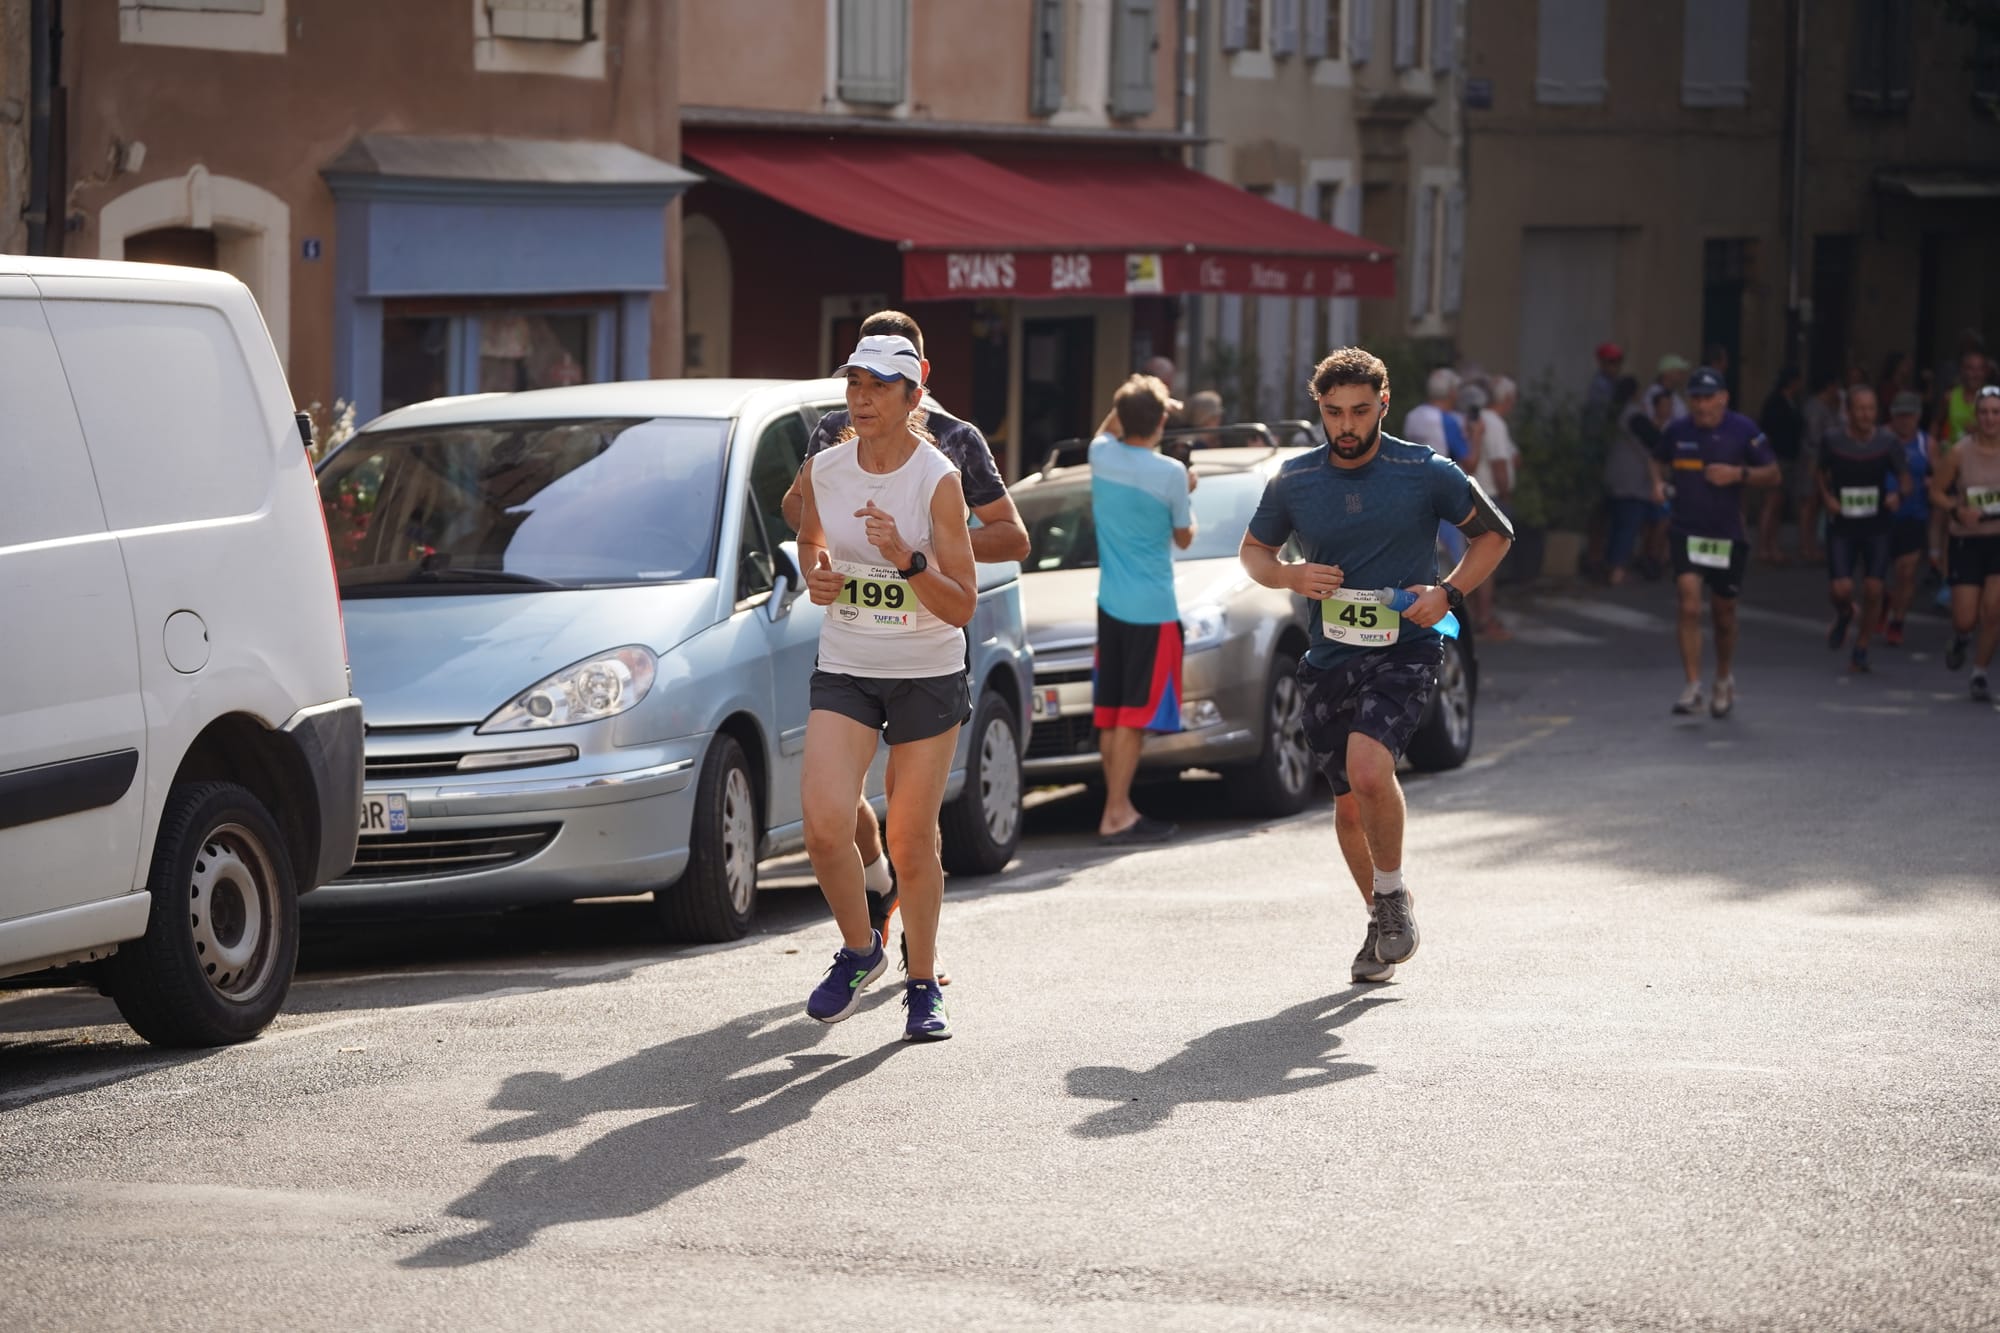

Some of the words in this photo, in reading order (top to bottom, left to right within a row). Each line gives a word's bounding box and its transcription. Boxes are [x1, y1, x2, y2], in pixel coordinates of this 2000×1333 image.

[947, 253, 1016, 289] RYAN'S
[1051, 253, 1091, 289] BAR
[844, 579, 904, 609] 199
[1339, 604, 1378, 628] 45
